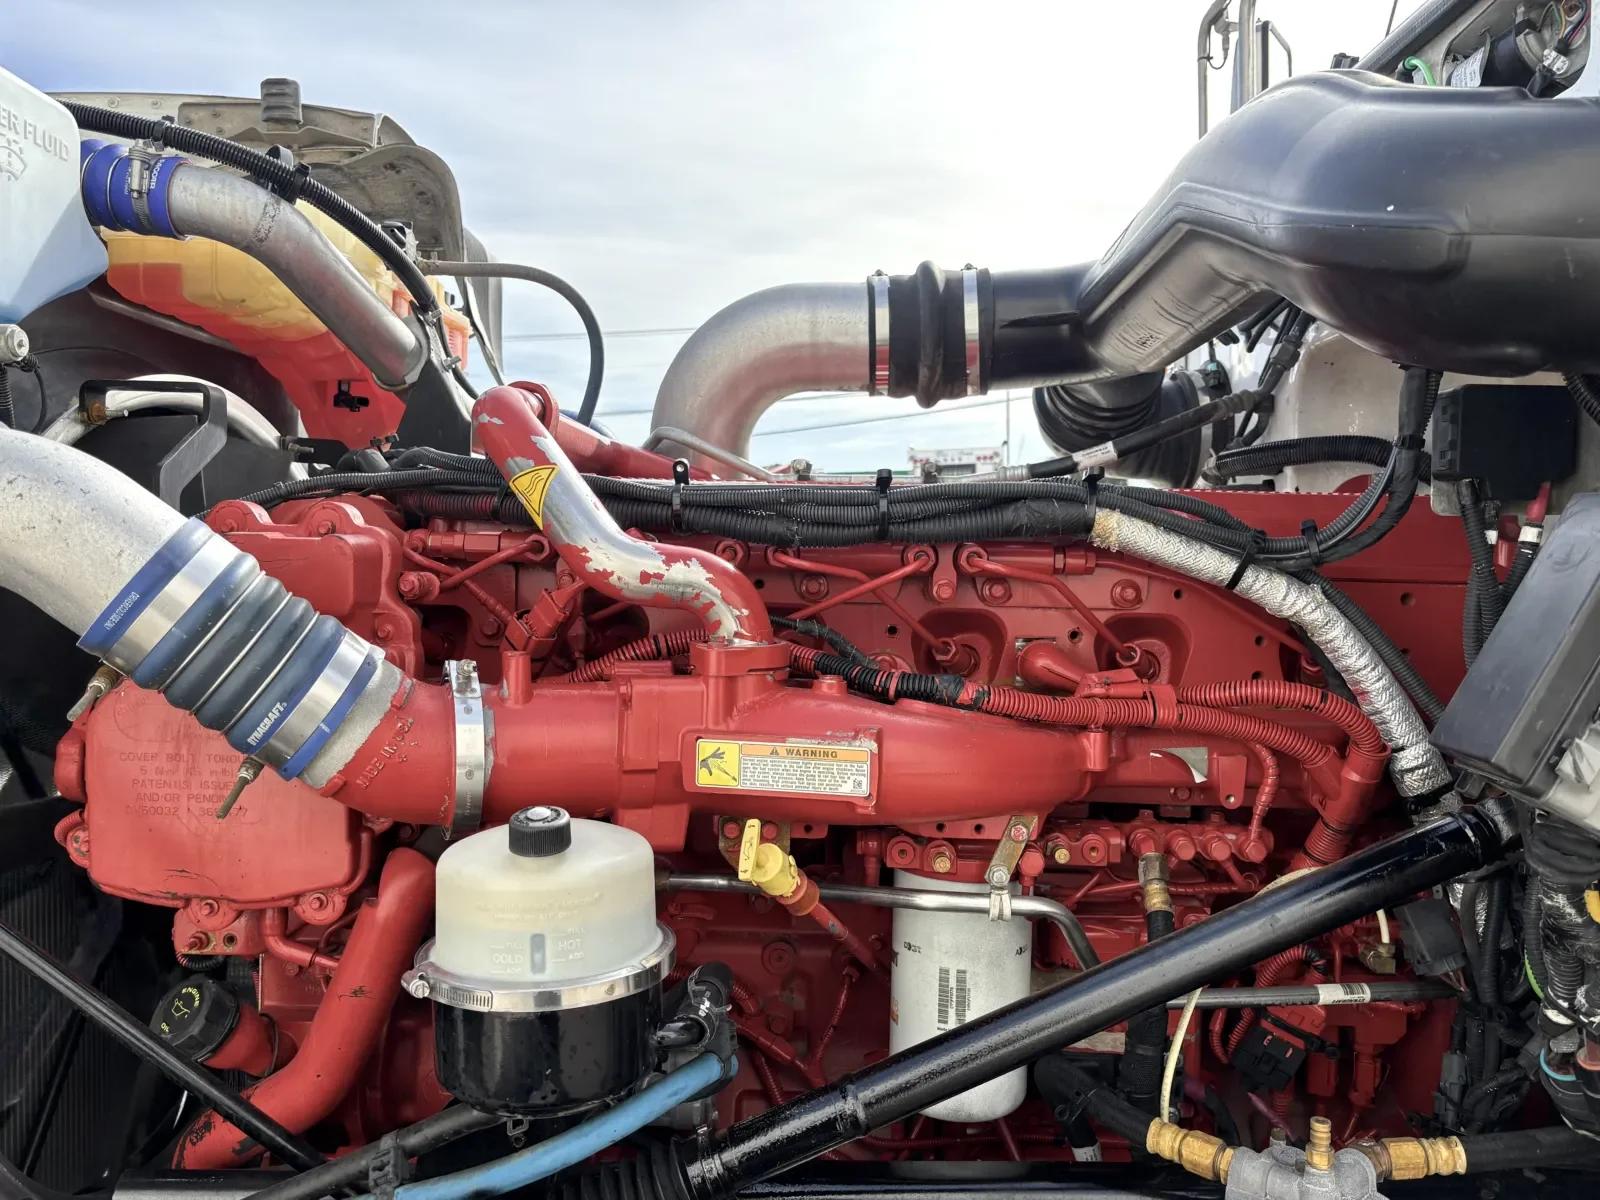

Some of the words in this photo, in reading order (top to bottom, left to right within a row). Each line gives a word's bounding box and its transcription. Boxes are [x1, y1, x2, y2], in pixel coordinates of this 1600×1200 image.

[24, 119, 70, 162] FLUID
[246, 702, 284, 747] DYNACRAFT
[119, 752, 158, 762] COVER
[785, 748, 838, 759] WARNING
[559, 938, 582, 951] HOT
[491, 952, 524, 965] COLD
